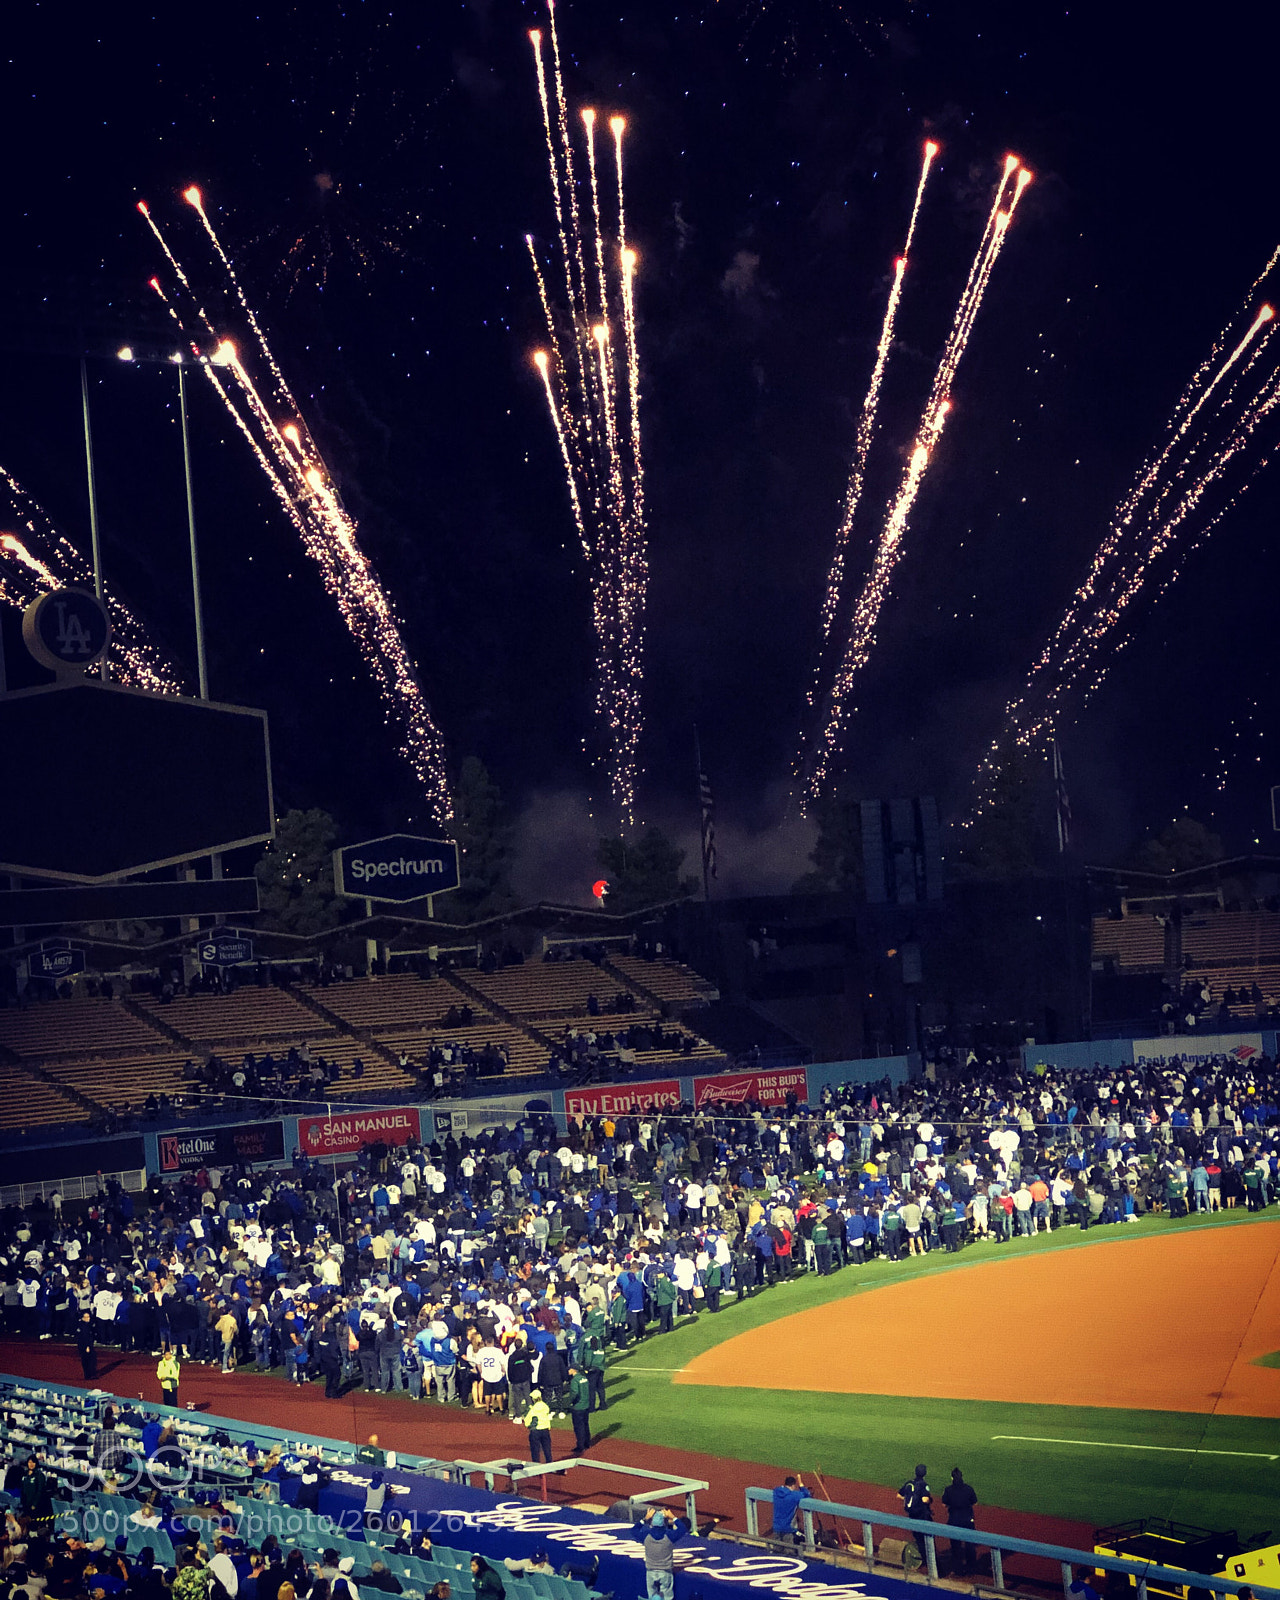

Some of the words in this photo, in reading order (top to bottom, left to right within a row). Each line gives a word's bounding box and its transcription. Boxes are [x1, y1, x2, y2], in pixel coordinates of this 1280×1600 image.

[54, 601, 91, 654] LA
[351, 857, 443, 882] Spectrum
[218, 942, 246, 952] Security
[757, 1077, 777, 1088] THIS
[779, 1073, 805, 1086] BUD'S
[702, 1087, 748, 1099] Budweiser
[758, 1088, 775, 1100] FOR
[777, 1086, 795, 1099] YO
[568, 1097, 598, 1116] Fly
[601, 1091, 681, 1113] Emirates
[323, 1119, 352, 1137] SAN
[355, 1114, 412, 1133] MANUEL
[233, 1132, 267, 1145] FAMILY
[324, 1134, 360, 1147] CASINO
[195, 1138, 216, 1153] One
[237, 1144, 265, 1156] MADE
[180, 1155, 204, 1165] VODKA
[483, 1357, 495, 1368] 22
